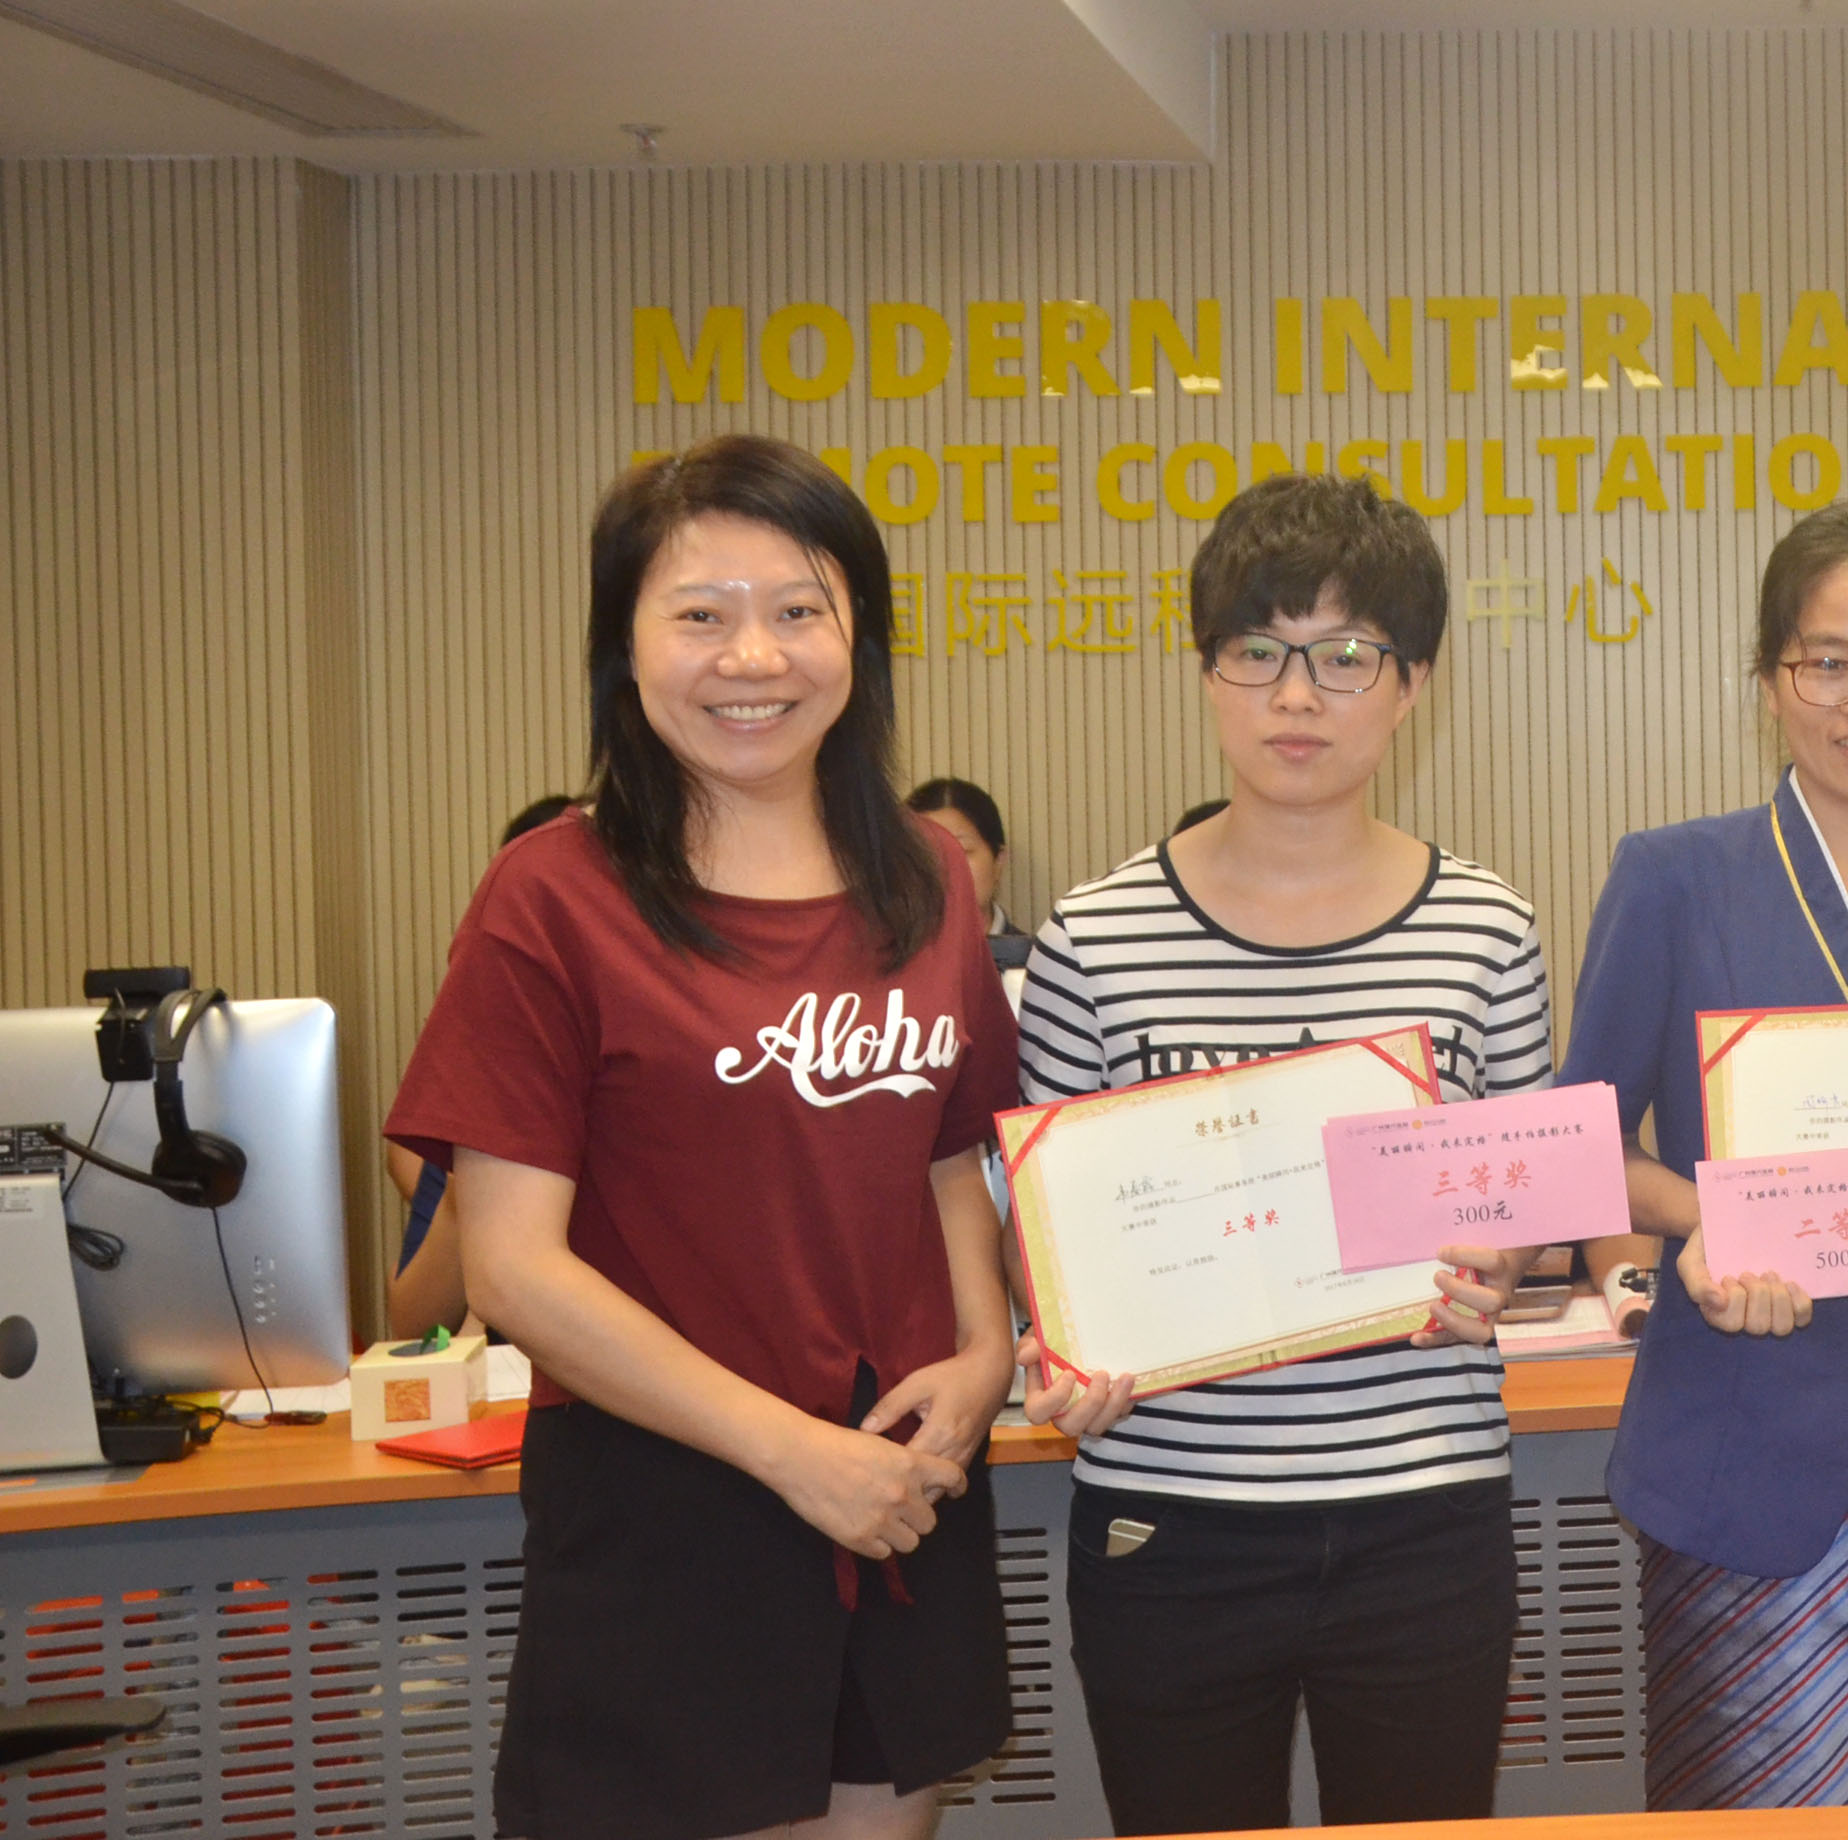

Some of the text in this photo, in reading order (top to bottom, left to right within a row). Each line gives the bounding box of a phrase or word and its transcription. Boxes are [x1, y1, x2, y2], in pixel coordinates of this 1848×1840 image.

[632, 298, 1223, 403] MODERN
[1466, 556, 1654, 649] 中心
[715, 988, 959, 1108] Aloha
[1431, 1159, 1533, 1197] 三等奖
[1223, 1208, 1280, 1238] 三等奖
[1453, 1200, 1513, 1226] 300元
